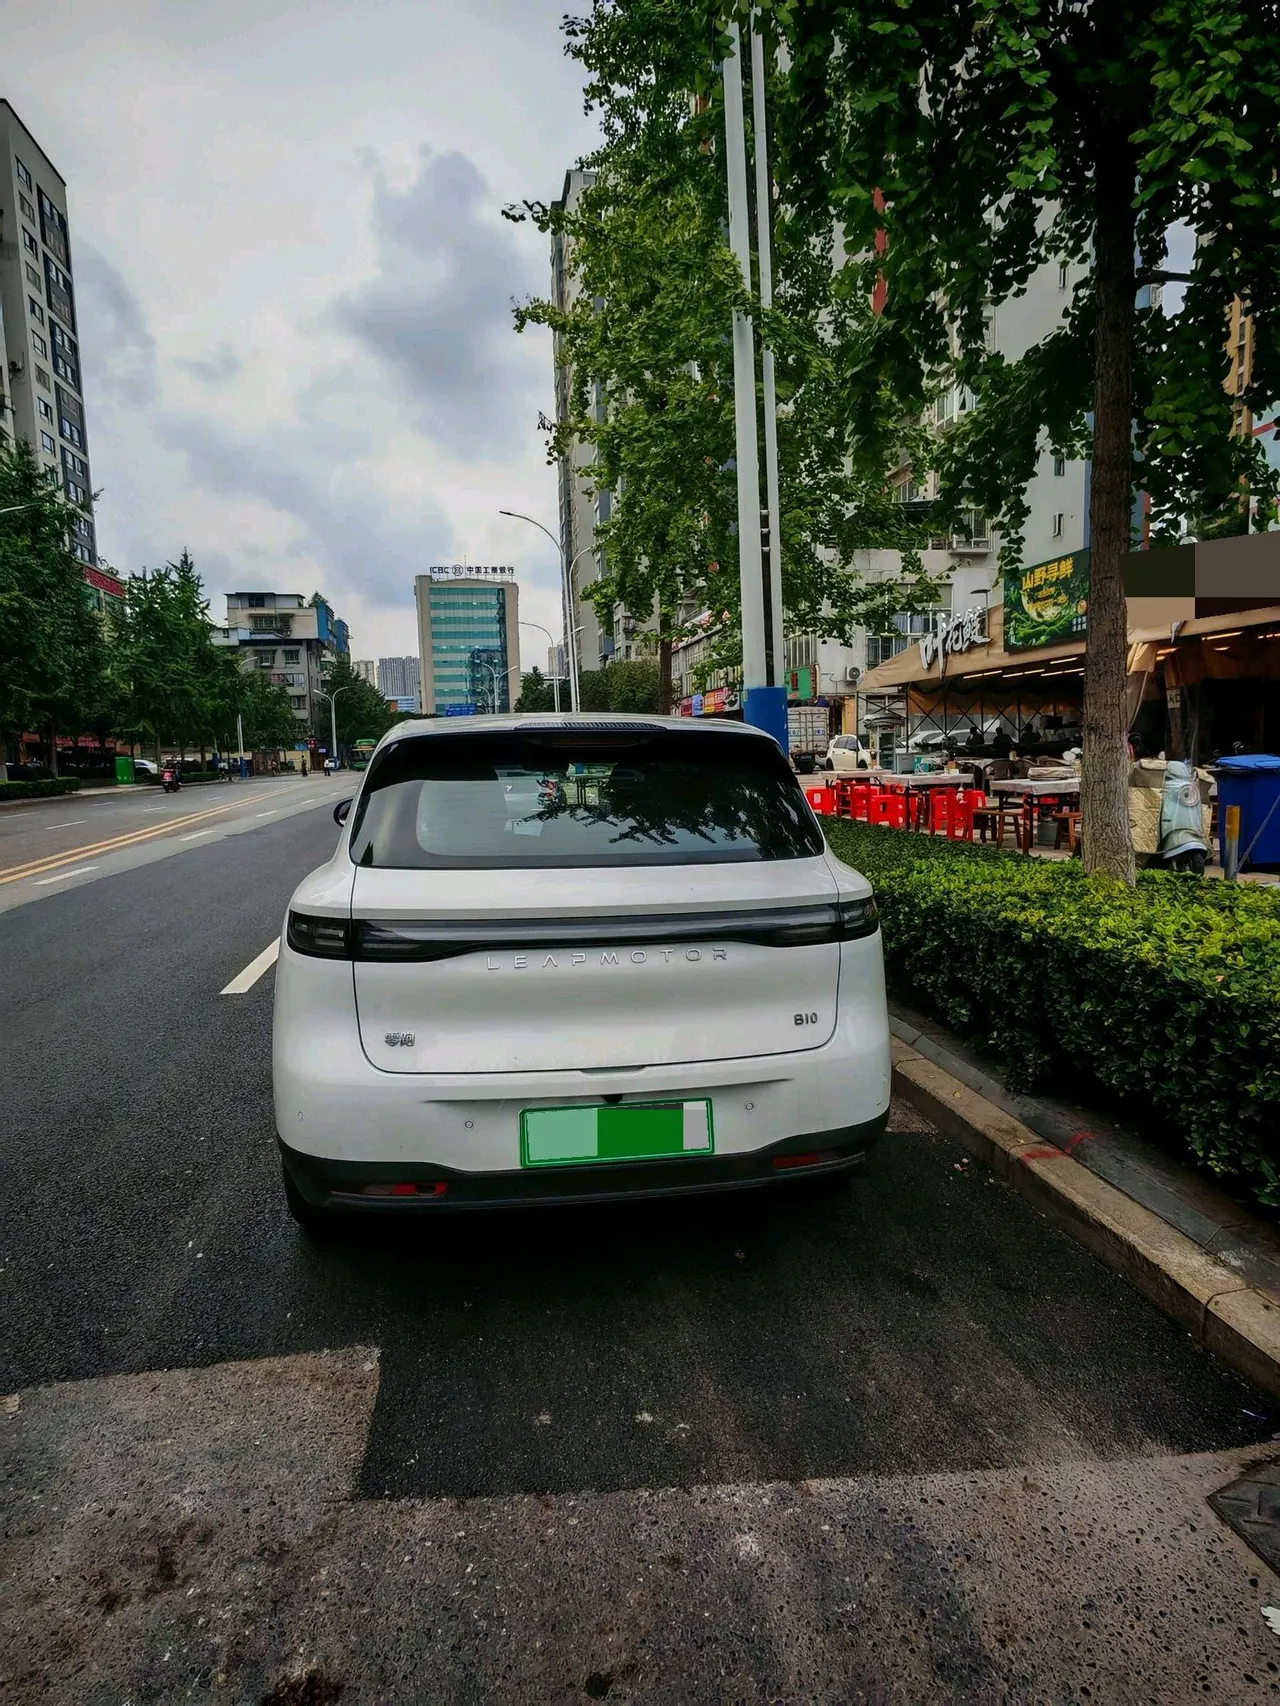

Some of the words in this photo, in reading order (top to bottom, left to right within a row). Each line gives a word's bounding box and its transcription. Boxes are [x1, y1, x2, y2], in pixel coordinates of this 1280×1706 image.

[429, 566, 449, 574] ICBC
[466, 566, 515, 574] 中国工商银行
[1022, 557, 1075, 590] 山野寻鲜
[487, 947, 728, 970] LEAPMOTOR
[794, 1012, 818, 1026] B10
